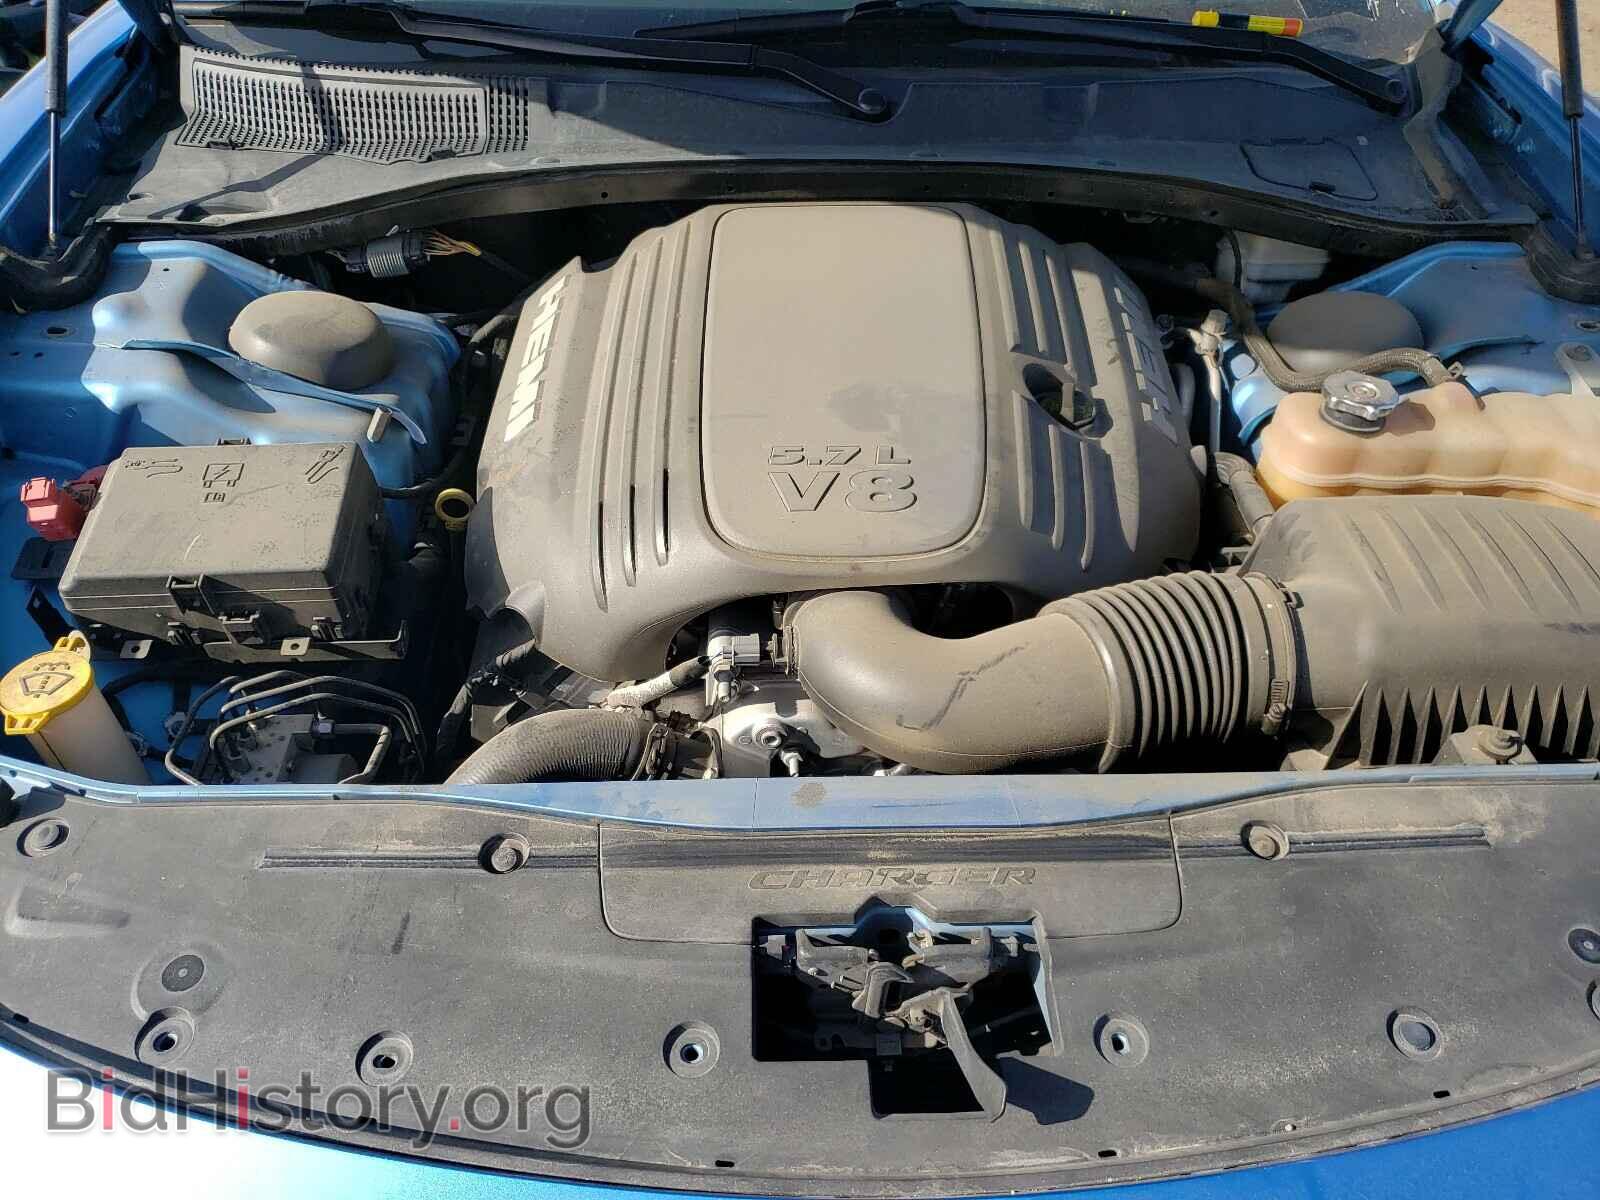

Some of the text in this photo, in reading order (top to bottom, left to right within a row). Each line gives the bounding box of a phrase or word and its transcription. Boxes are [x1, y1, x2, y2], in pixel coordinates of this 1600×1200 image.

[503, 274, 568, 443] HEMI
[767, 470, 918, 512] V8
[748, 865, 1037, 890] CHARGER
